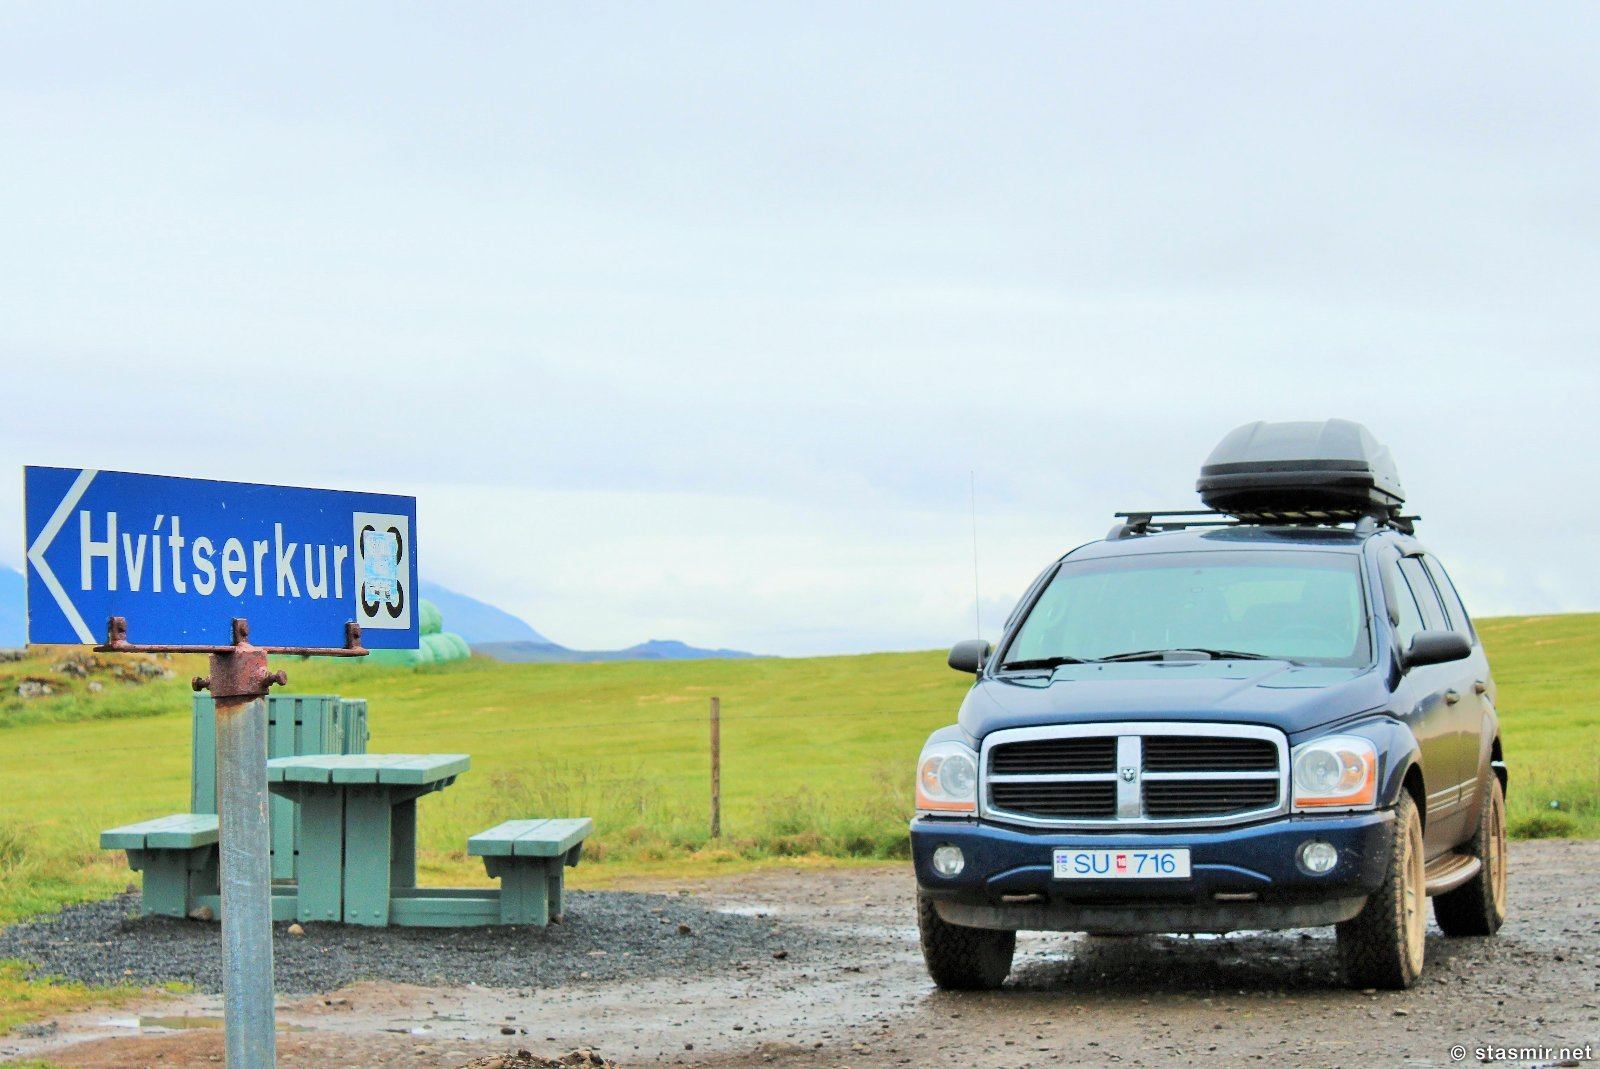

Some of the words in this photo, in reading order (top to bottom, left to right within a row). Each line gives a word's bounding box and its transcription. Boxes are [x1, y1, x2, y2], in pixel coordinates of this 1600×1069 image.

[79, 510, 348, 600] Hvítserkur
[1056, 864, 1068, 872] IS
[1074, 854, 1110, 873] SU
[1133, 854, 1176, 873] 716
